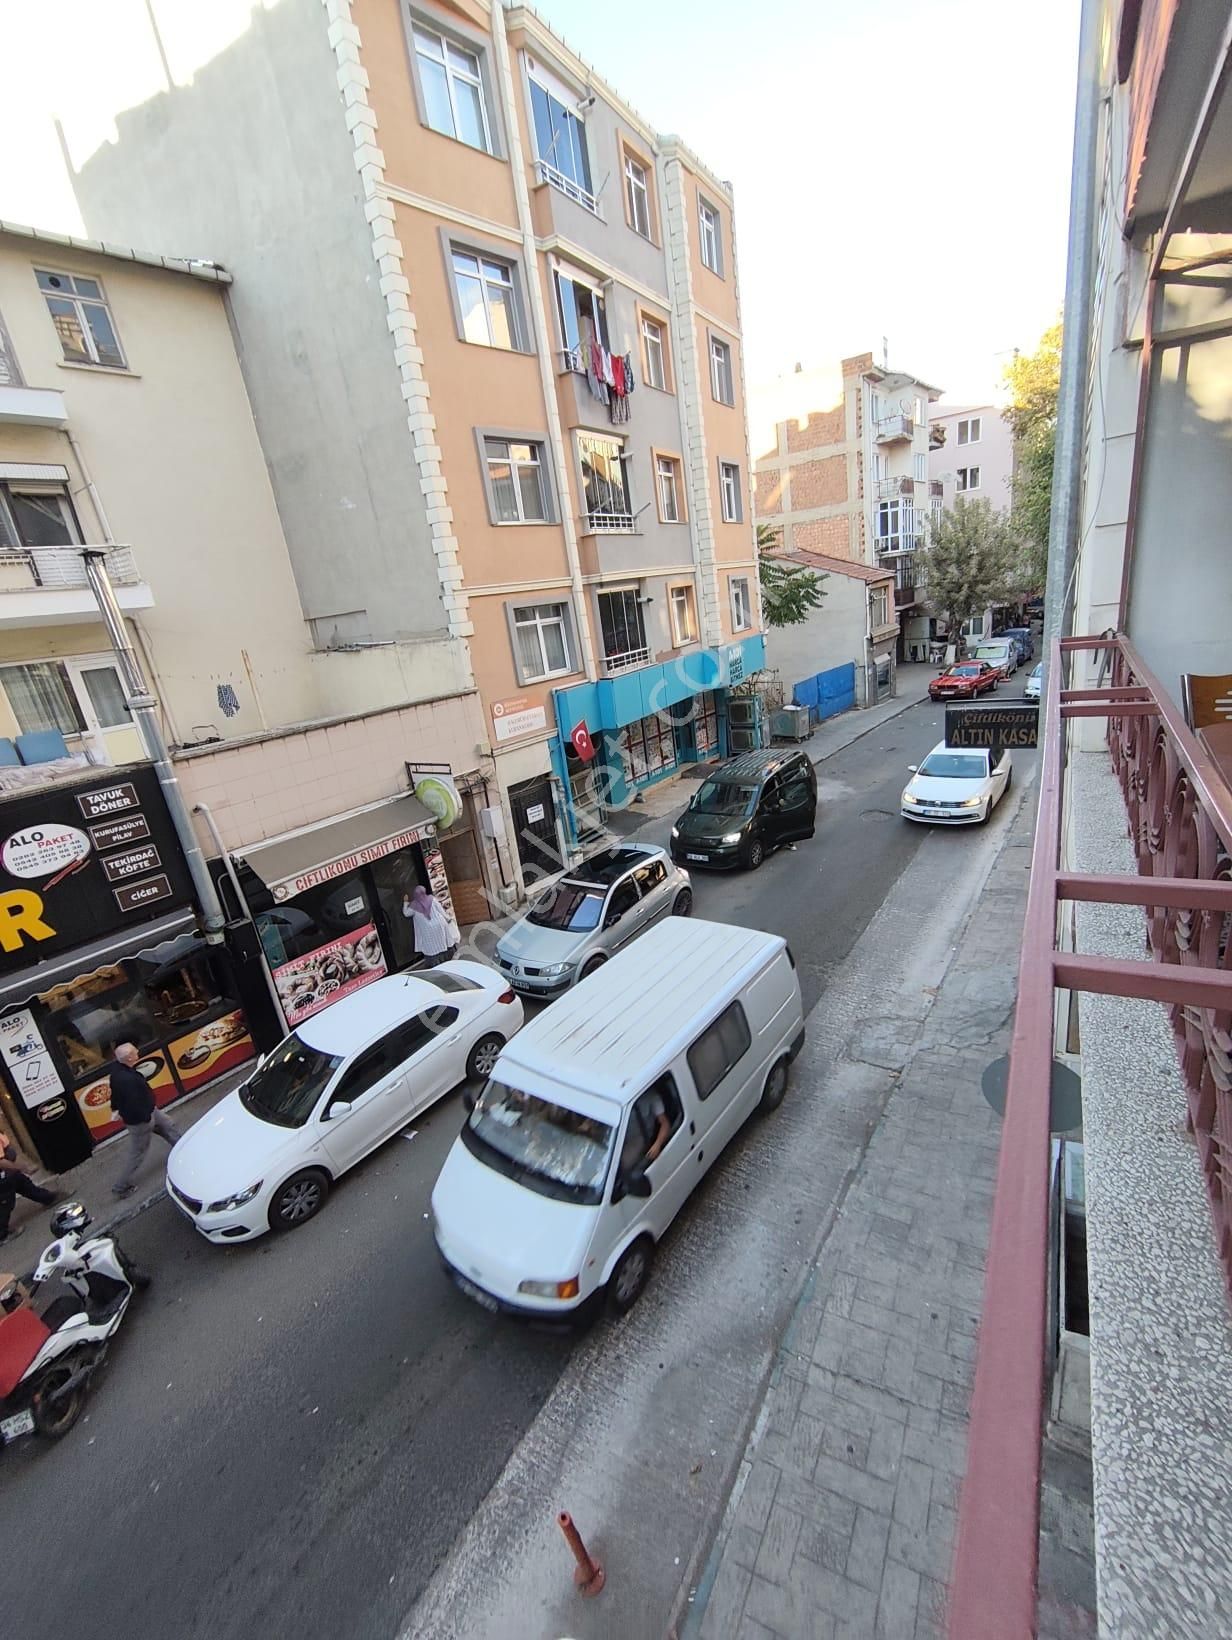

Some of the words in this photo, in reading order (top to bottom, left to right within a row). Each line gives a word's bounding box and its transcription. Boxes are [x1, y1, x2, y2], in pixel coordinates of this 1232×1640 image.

[951, 729, 994, 745] ALTIN
[998, 729, 1038, 745] KASA
[86, 789, 124, 805] TAVUK
[90, 797, 132, 814] DÖNER
[94, 819, 145, 838] KURUFASÜLYE
[112, 831, 132, 842] PİLAV
[9, 832, 44, 849] ALO
[37, 833, 74, 849] PAKET
[392, 830, 420, 850] FIRINI
[108, 849, 155, 869] TEKİRDAĞ
[119, 860, 151, 875] KÖFTE
[130, 886, 159, 901] CİĞER
[1, 1017, 20, 1029] ALO
